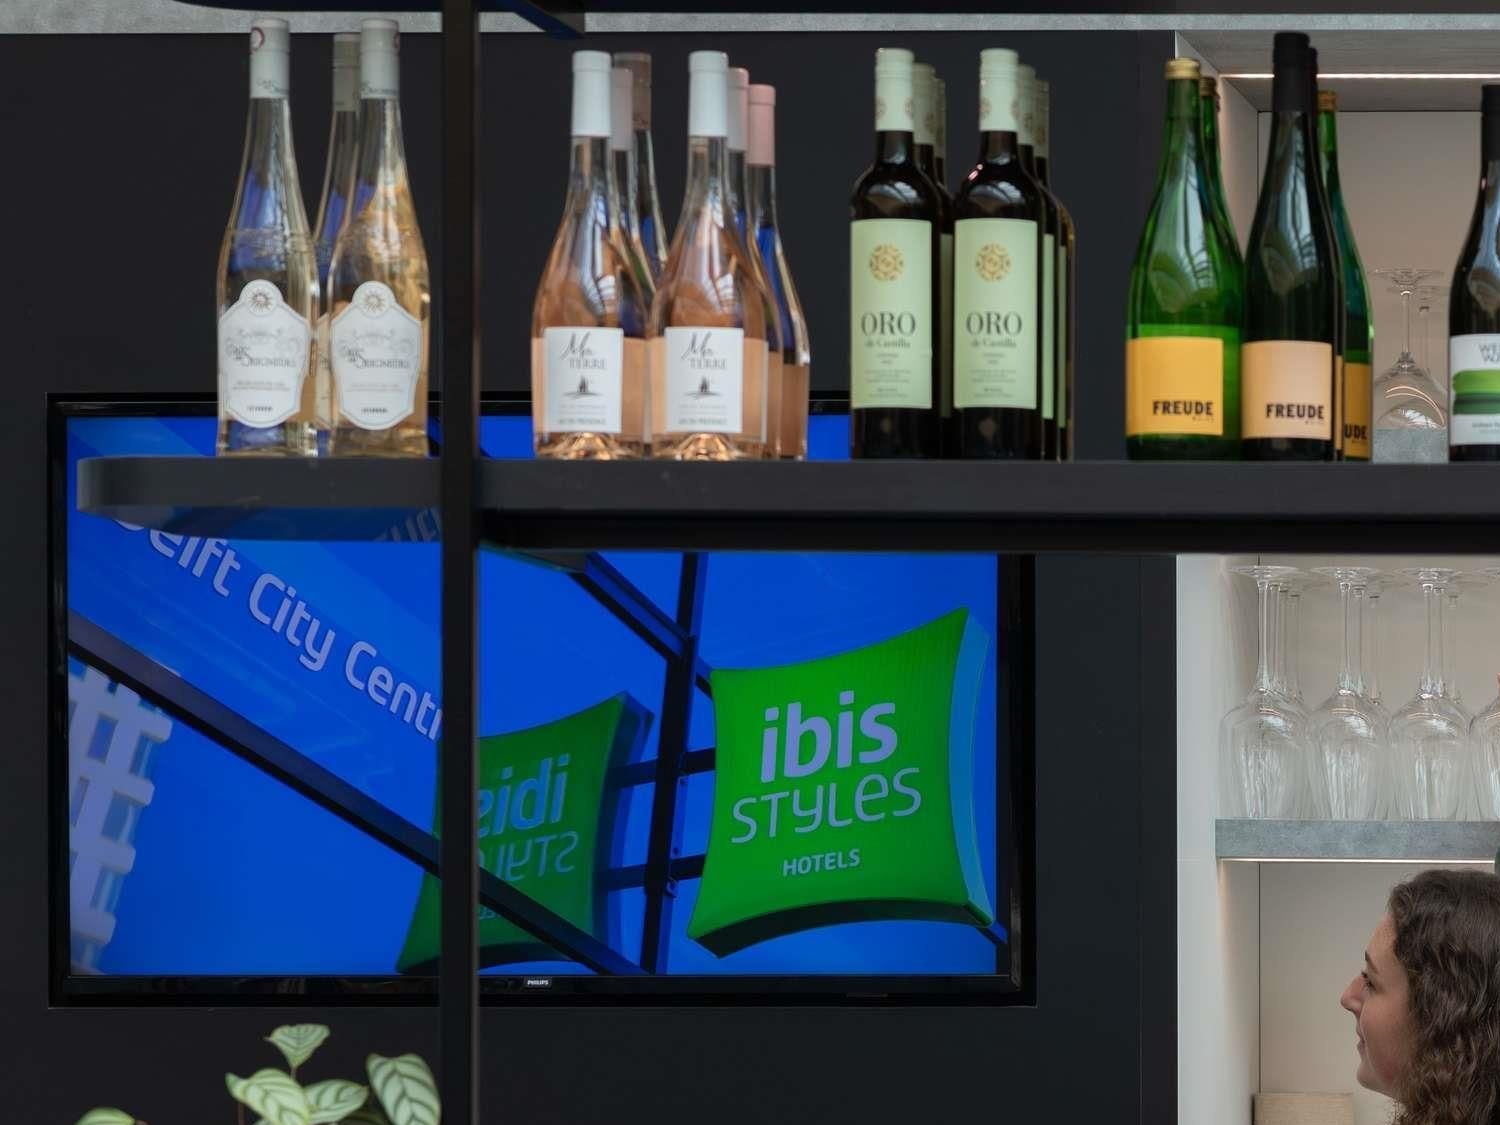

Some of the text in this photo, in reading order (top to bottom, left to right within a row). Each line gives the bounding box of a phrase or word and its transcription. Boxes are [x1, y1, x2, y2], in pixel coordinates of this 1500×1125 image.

[861, 312, 916, 336] ORO
[966, 312, 1022, 336] ORO
[1153, 401, 1214, 416] FREUDE
[1266, 404, 1325, 419] FREUDE
[1344, 424, 1368, 440] UDE
[112, 518, 241, 597] elft
[249, 573, 336, 671] City
[761, 691, 899, 784] ibis
[782, 848, 861, 877] HOTELS
